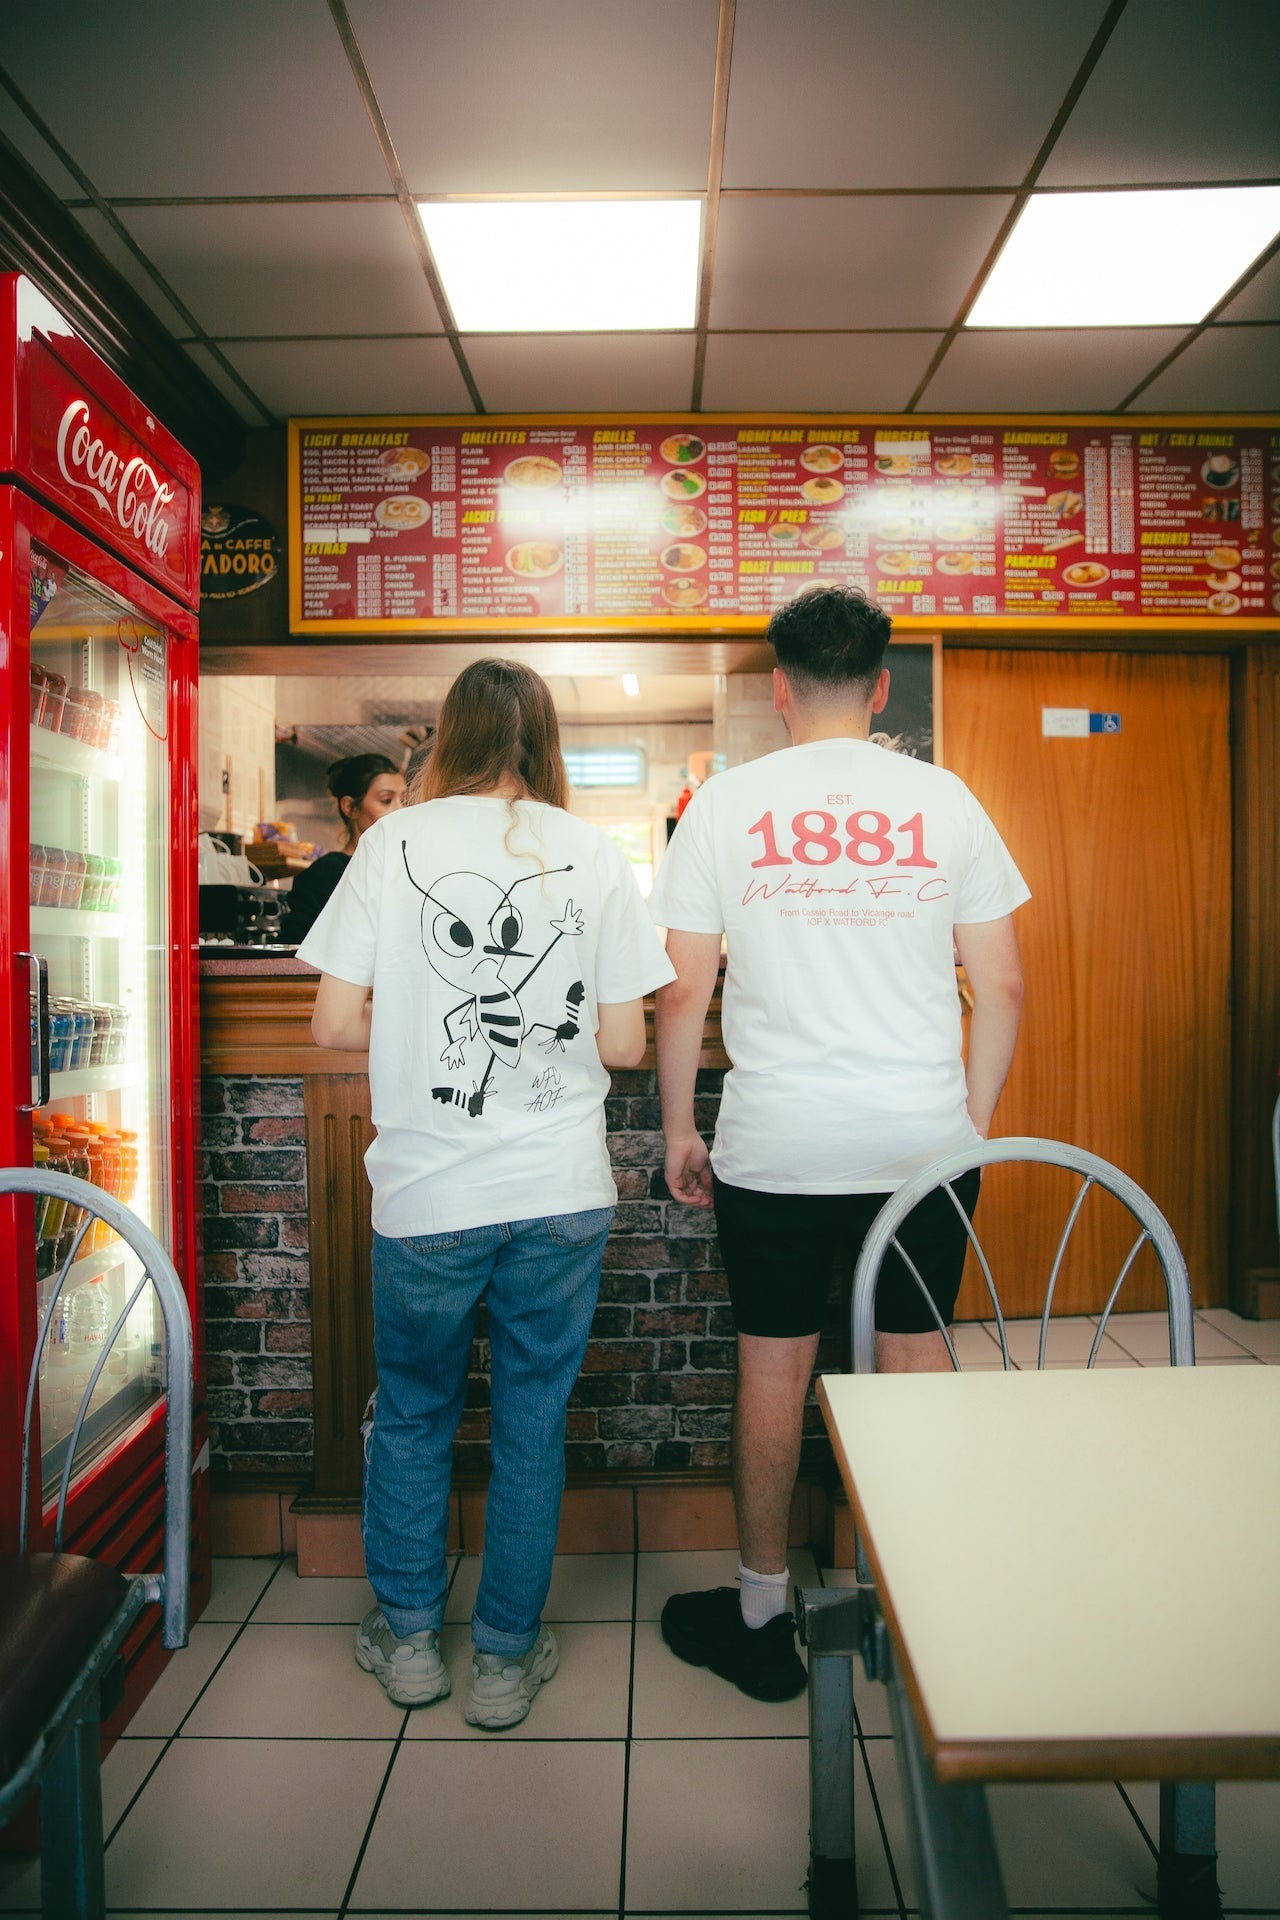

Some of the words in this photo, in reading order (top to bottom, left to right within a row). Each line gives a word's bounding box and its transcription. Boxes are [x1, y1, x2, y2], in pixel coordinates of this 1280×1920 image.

[304, 433, 338, 447] LIGHT
[341, 433, 409, 447] BREAKFAST
[461, 432, 526, 444] OMELETTES
[593, 430, 636, 444] GRILLS
[737, 430, 804, 443] HOMEMADE
[807, 430, 860, 443] DINNERS
[57, 399, 175, 558] Coca-Cola
[739, 510, 767, 523] FISH
[779, 510, 808, 523] PIES
[304, 543, 348, 555] EXTRAS
[200, 553, 274, 574] ADORO
[877, 580, 923, 593] SALADS
[826, 794, 854, 805] EST.
[748, 810, 938, 868] 1881
[742, 873, 860, 906] Watford
[780, 908, 800, 918] From
[829, 908, 849, 918] Road
[851, 909, 859, 918] to
[897, 910, 914, 918] road
[824, 918, 830, 926] X
[830, 918, 877, 926] WATFORD
[524, 1086, 567, 1112] AOF
